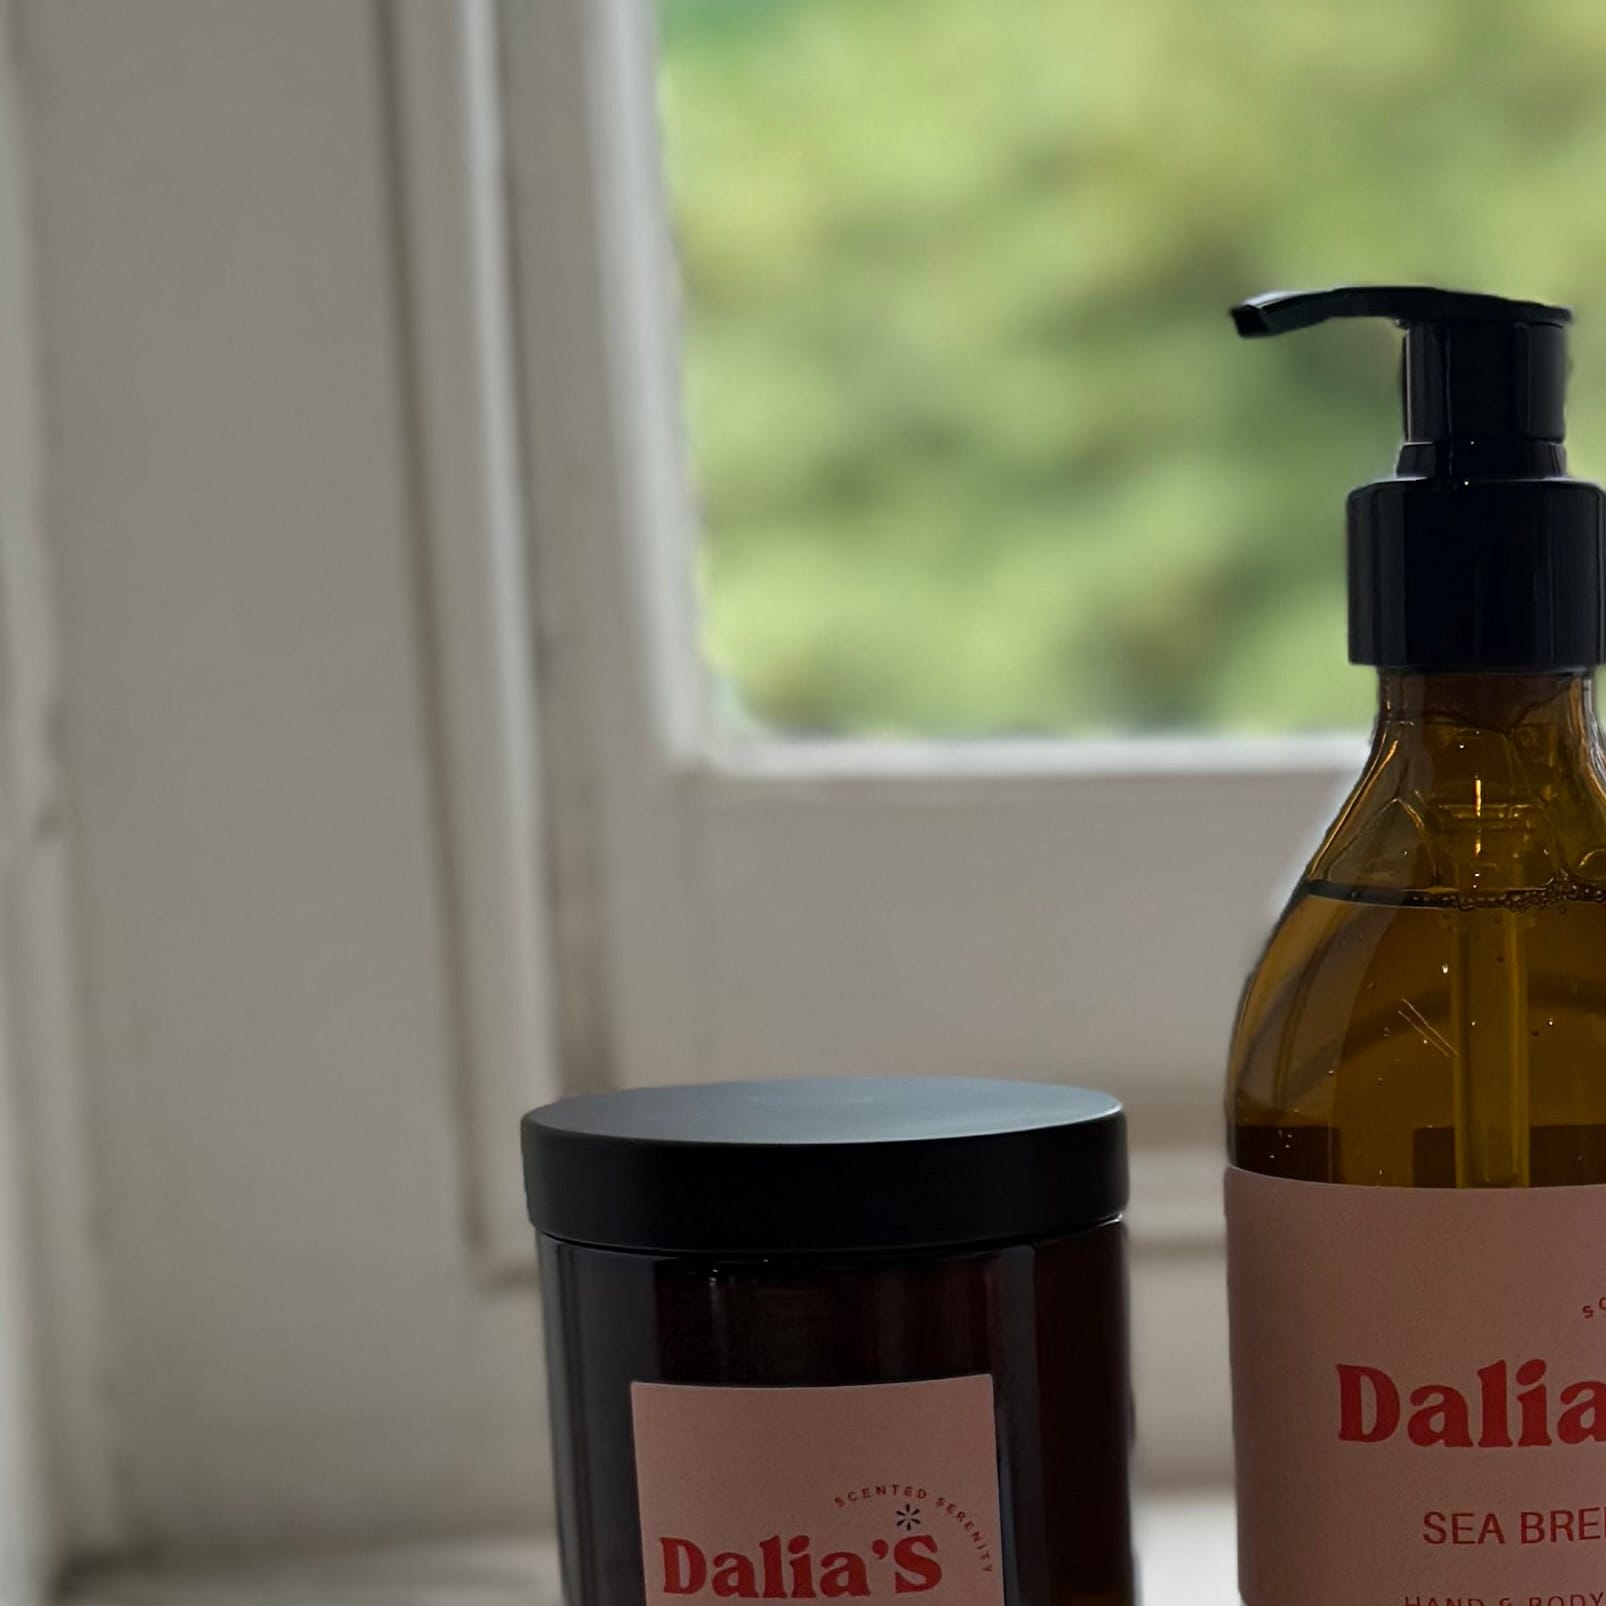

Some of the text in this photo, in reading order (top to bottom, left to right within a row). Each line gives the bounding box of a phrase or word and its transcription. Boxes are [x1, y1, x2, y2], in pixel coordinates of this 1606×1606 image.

[834, 1484, 993, 1573] SCENTED SERENITY
[1422, 1510, 1506, 1546] SEA
